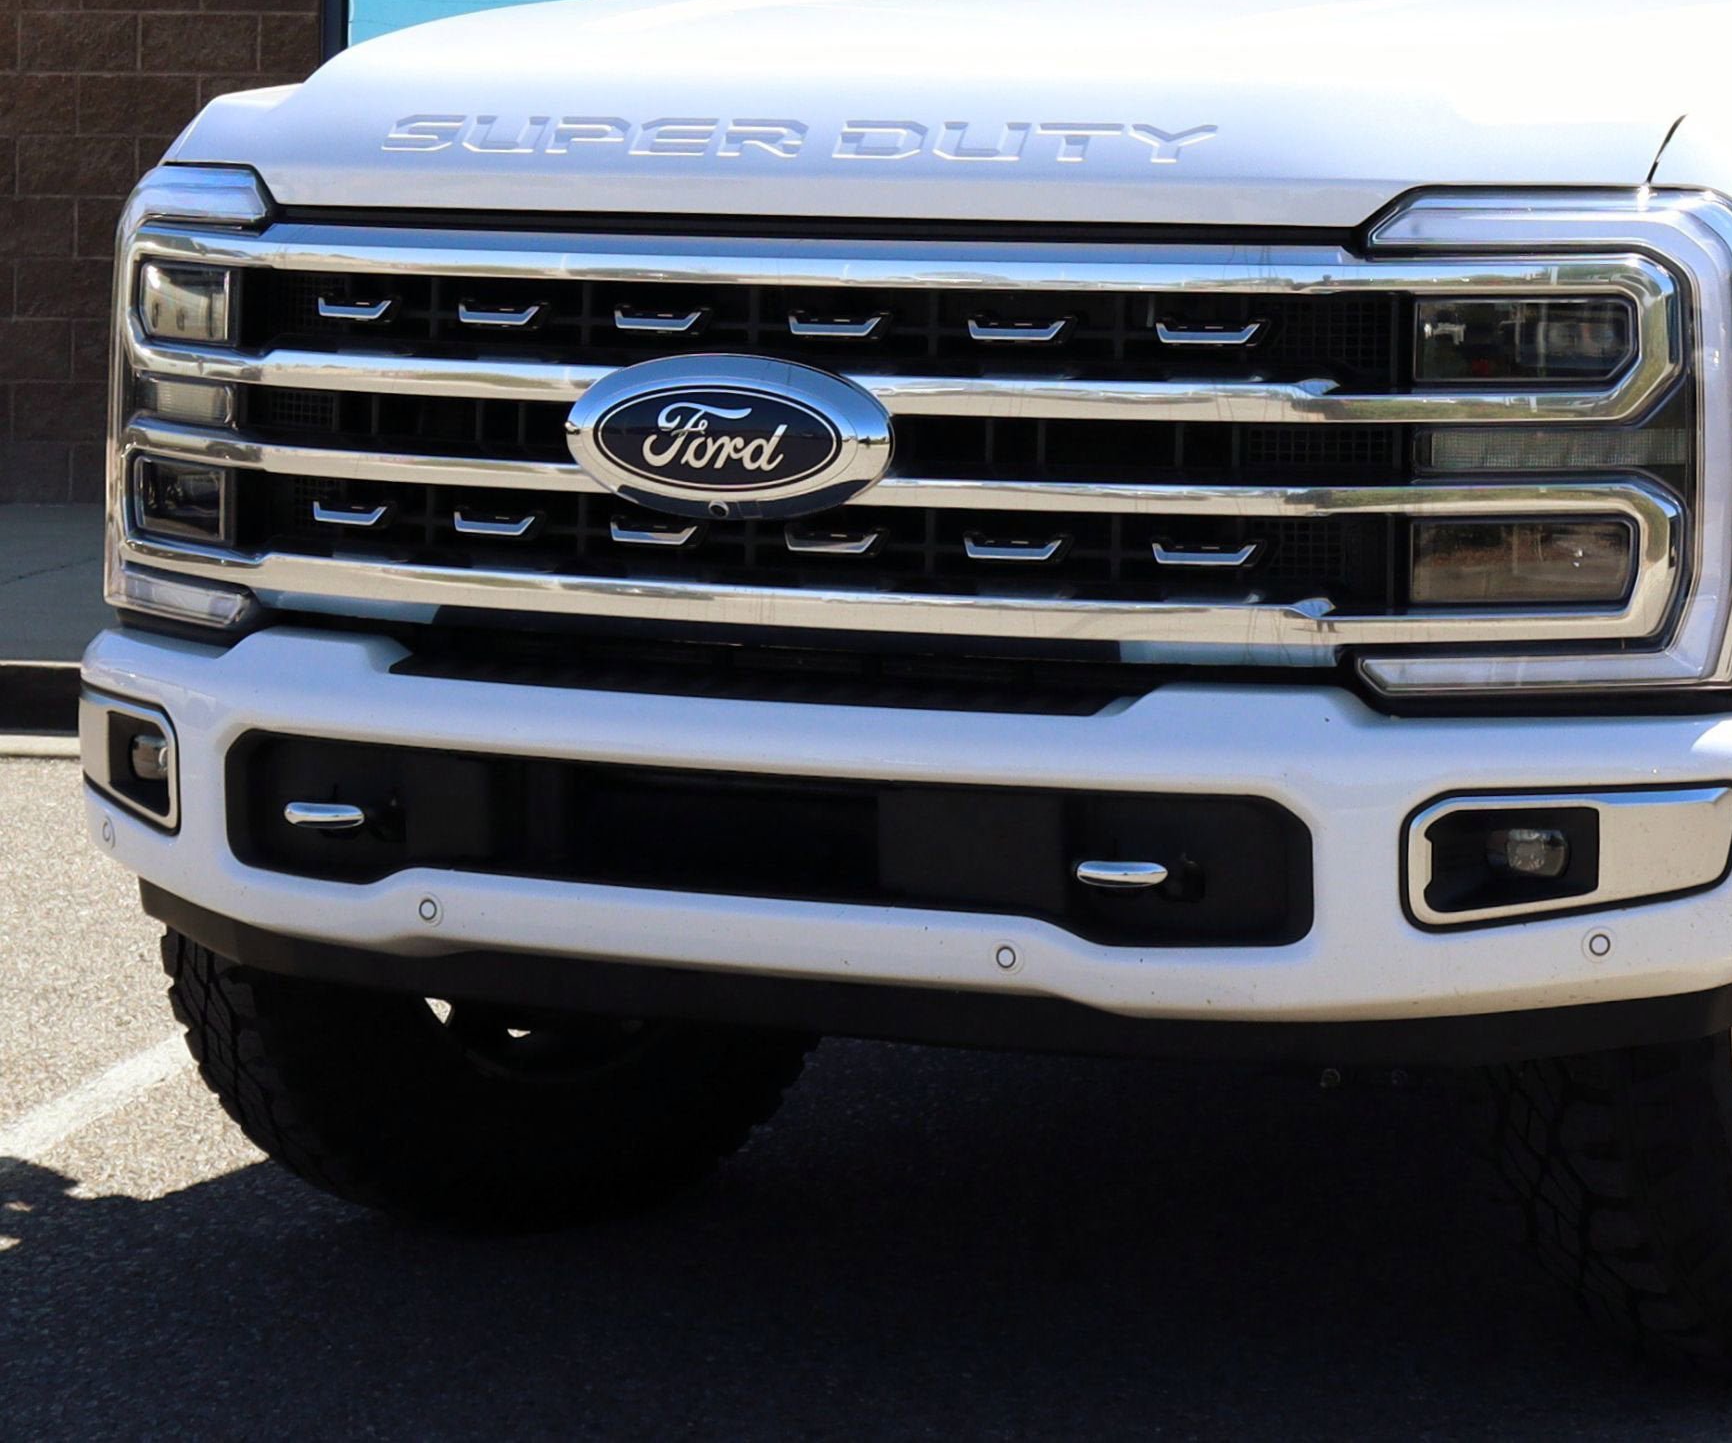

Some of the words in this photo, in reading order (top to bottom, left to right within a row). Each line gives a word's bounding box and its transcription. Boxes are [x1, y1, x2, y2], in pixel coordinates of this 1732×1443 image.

[380, 114, 810, 158] SUPER
[831, 120, 1219, 164] DUTY
[642, 401, 788, 472] Ford
